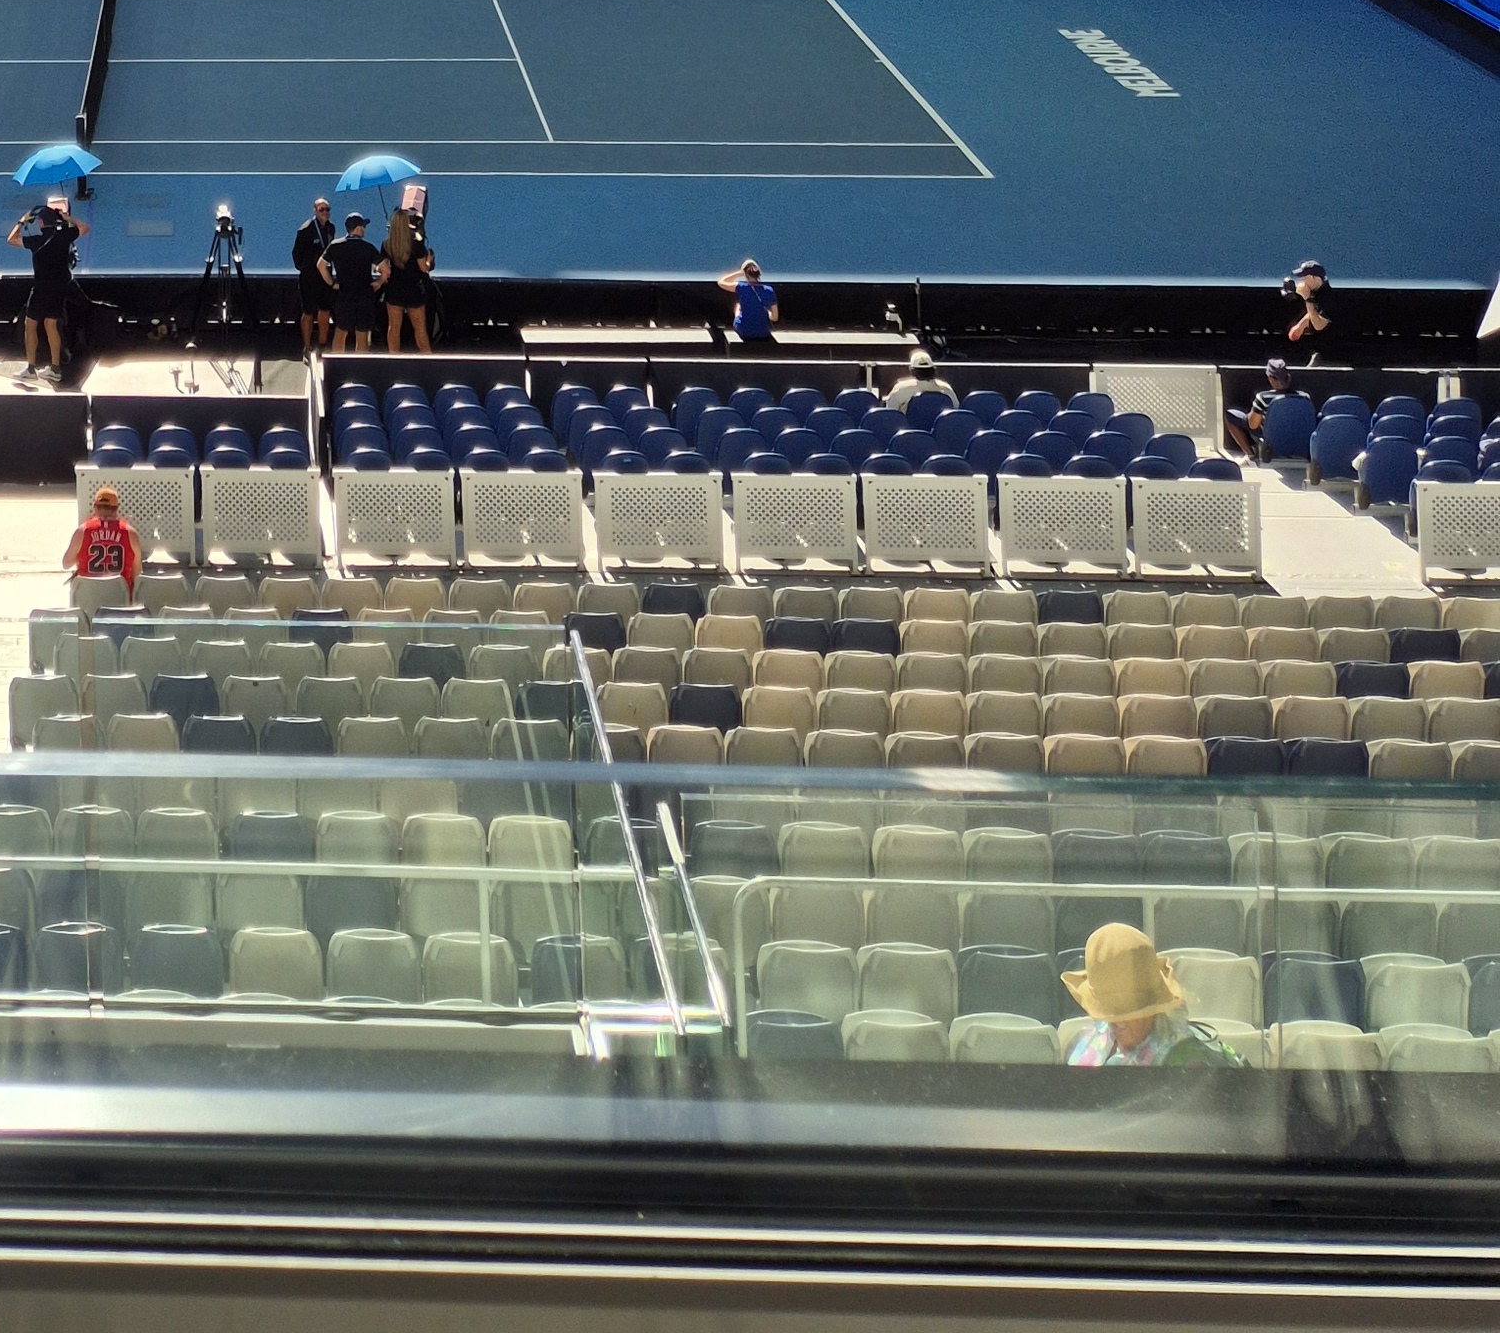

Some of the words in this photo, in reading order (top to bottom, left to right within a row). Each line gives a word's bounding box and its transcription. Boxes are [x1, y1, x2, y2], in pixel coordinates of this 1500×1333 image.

[1058, 29, 1181, 97] MELBOURNE
[90, 530, 122, 543] JORDAN
[87, 543, 125, 573] 23
